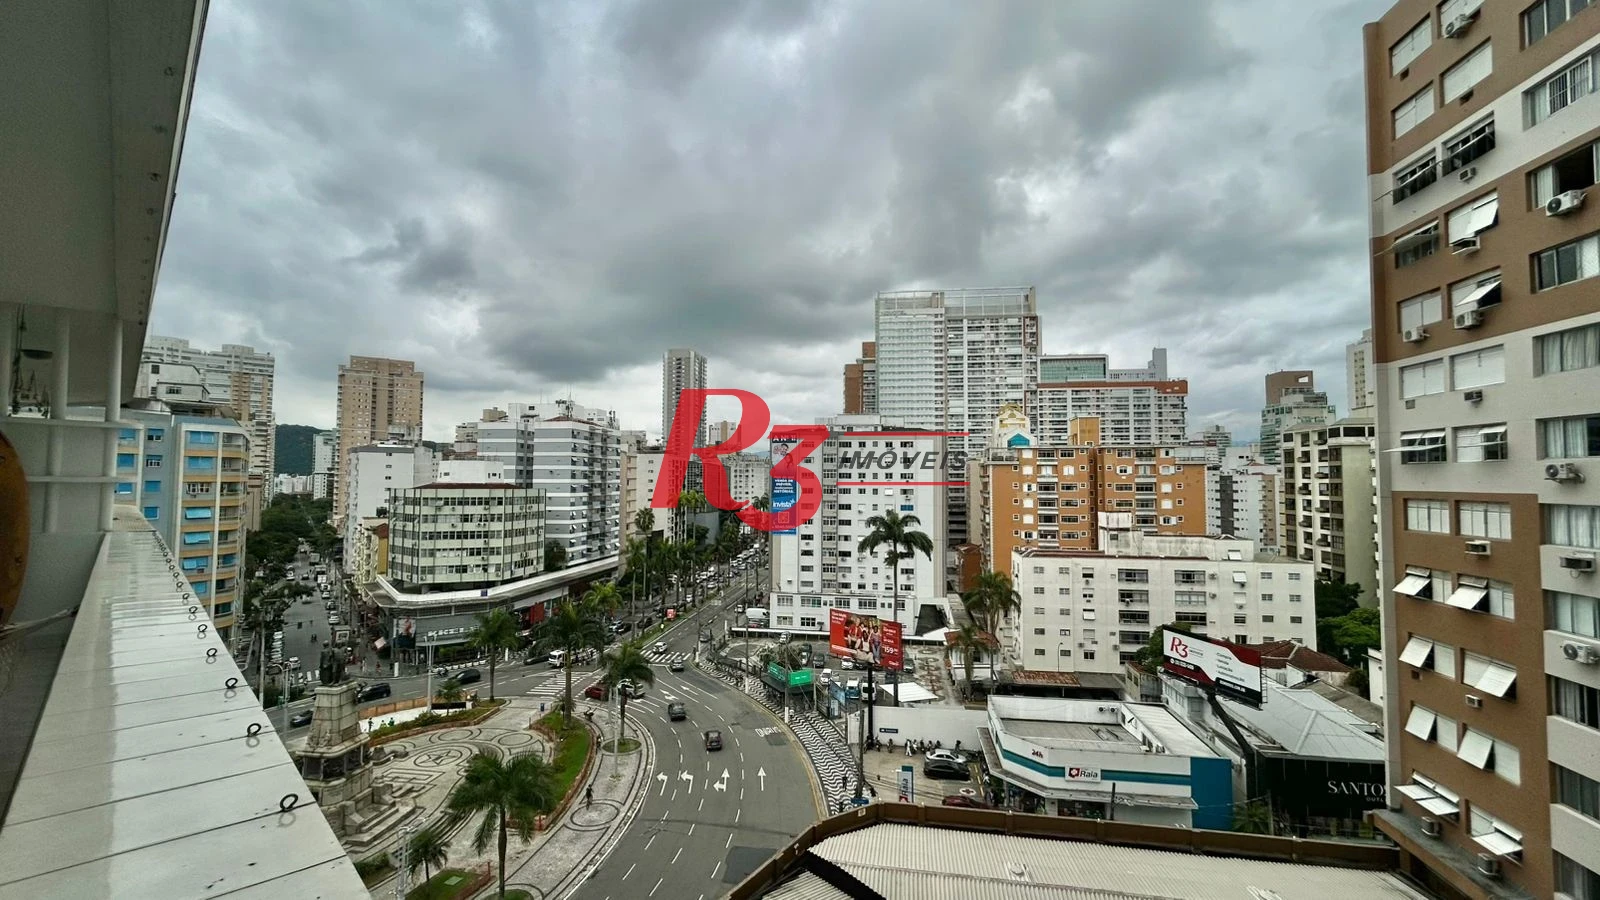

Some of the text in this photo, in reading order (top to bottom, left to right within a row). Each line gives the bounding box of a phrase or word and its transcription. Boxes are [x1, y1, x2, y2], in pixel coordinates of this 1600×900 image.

[1170, 636, 1189, 658] R3
[1031, 749, 1044, 759] 24h
[1080, 770, 1098, 778] Raia
[901, 778, 910, 796] Raia
[1327, 780, 1386, 797] SANTO
